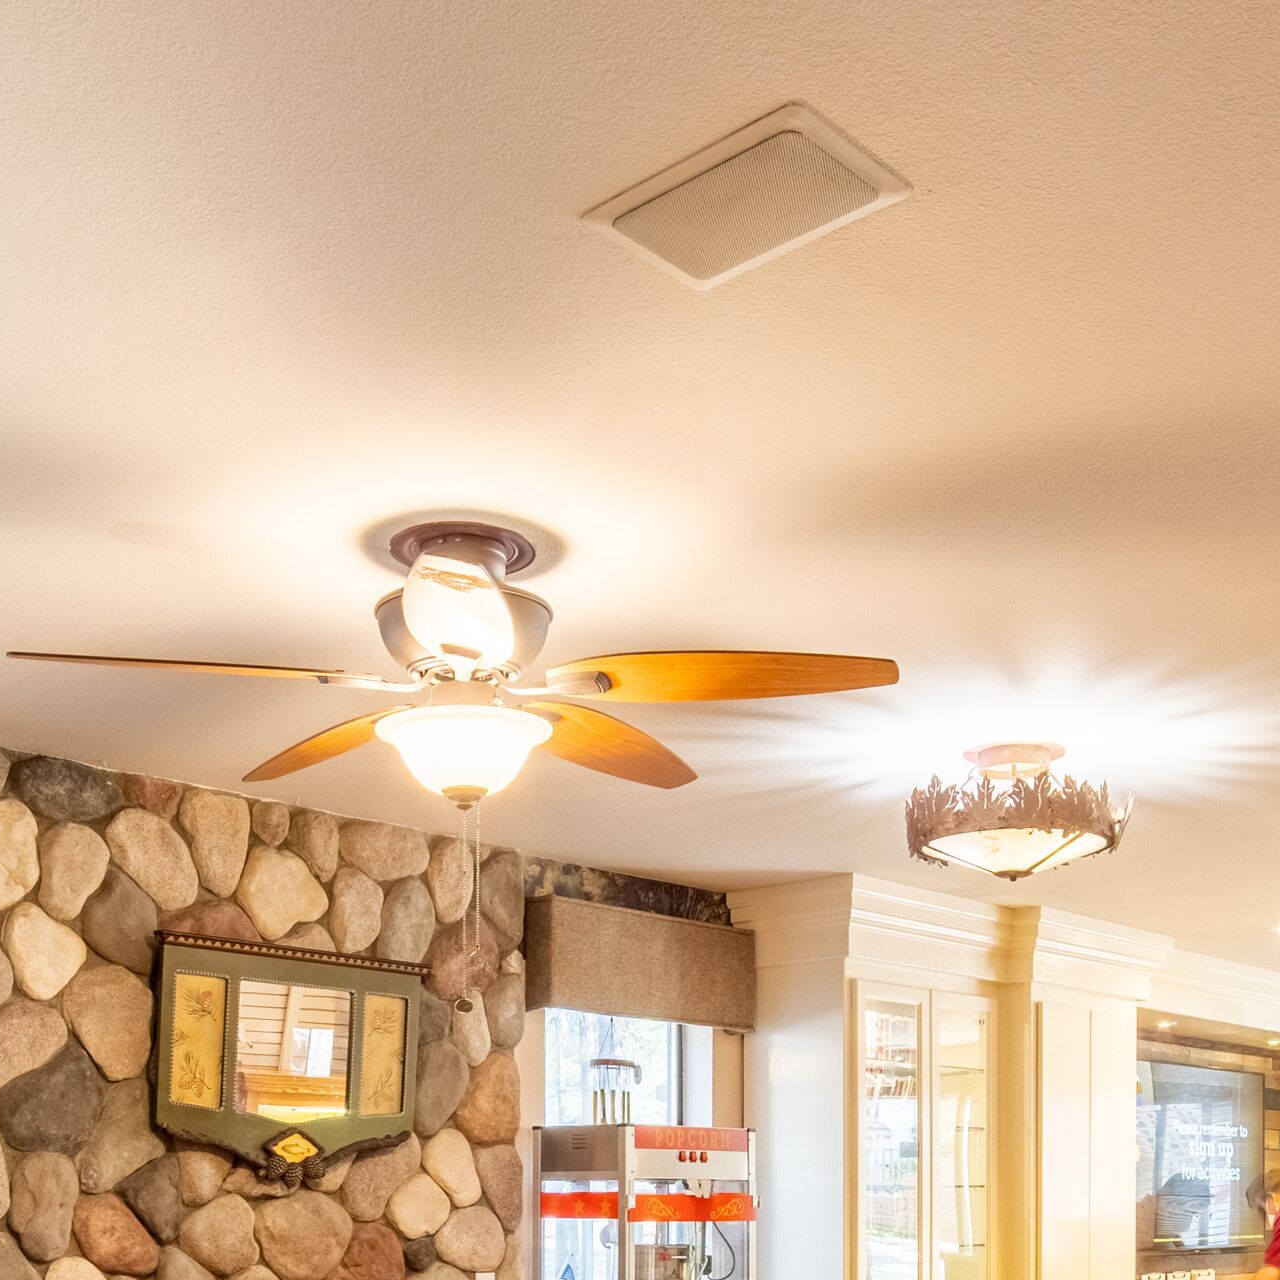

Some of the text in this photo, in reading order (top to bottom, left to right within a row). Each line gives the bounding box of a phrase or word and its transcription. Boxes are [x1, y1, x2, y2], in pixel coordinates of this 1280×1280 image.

[655, 1128, 730, 1149] POPCORN
[1200, 1121, 1238, 1137] remember
[1239, 1124, 1248, 1138] to
[1189, 1136, 1234, 1163] sign up
[1182, 1162, 1241, 1181] for activities
